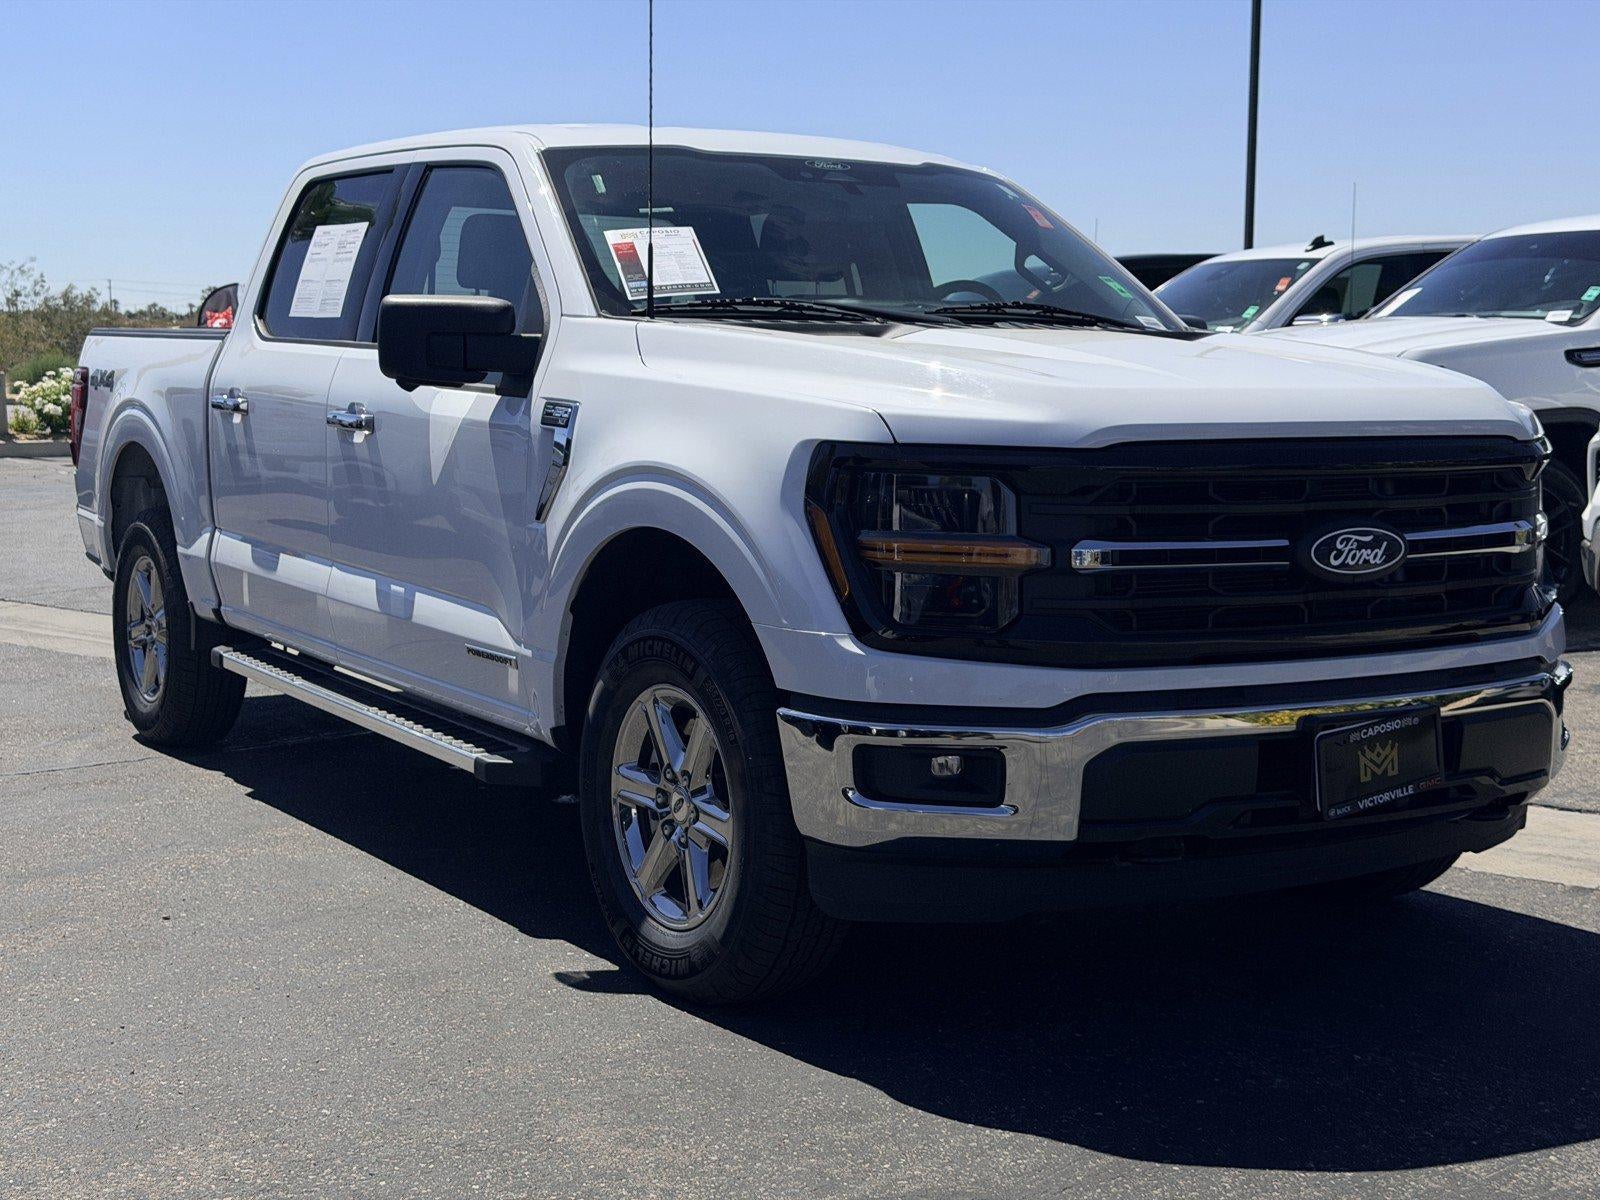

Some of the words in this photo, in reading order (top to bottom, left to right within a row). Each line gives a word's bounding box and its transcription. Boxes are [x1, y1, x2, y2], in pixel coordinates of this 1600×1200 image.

[1330, 534, 1388, 566] Ford
[627, 640, 696, 674] MICHELIN
[1360, 719, 1402, 739] CAPOSIO
[1357, 784, 1414, 810] VICTORVILLE
